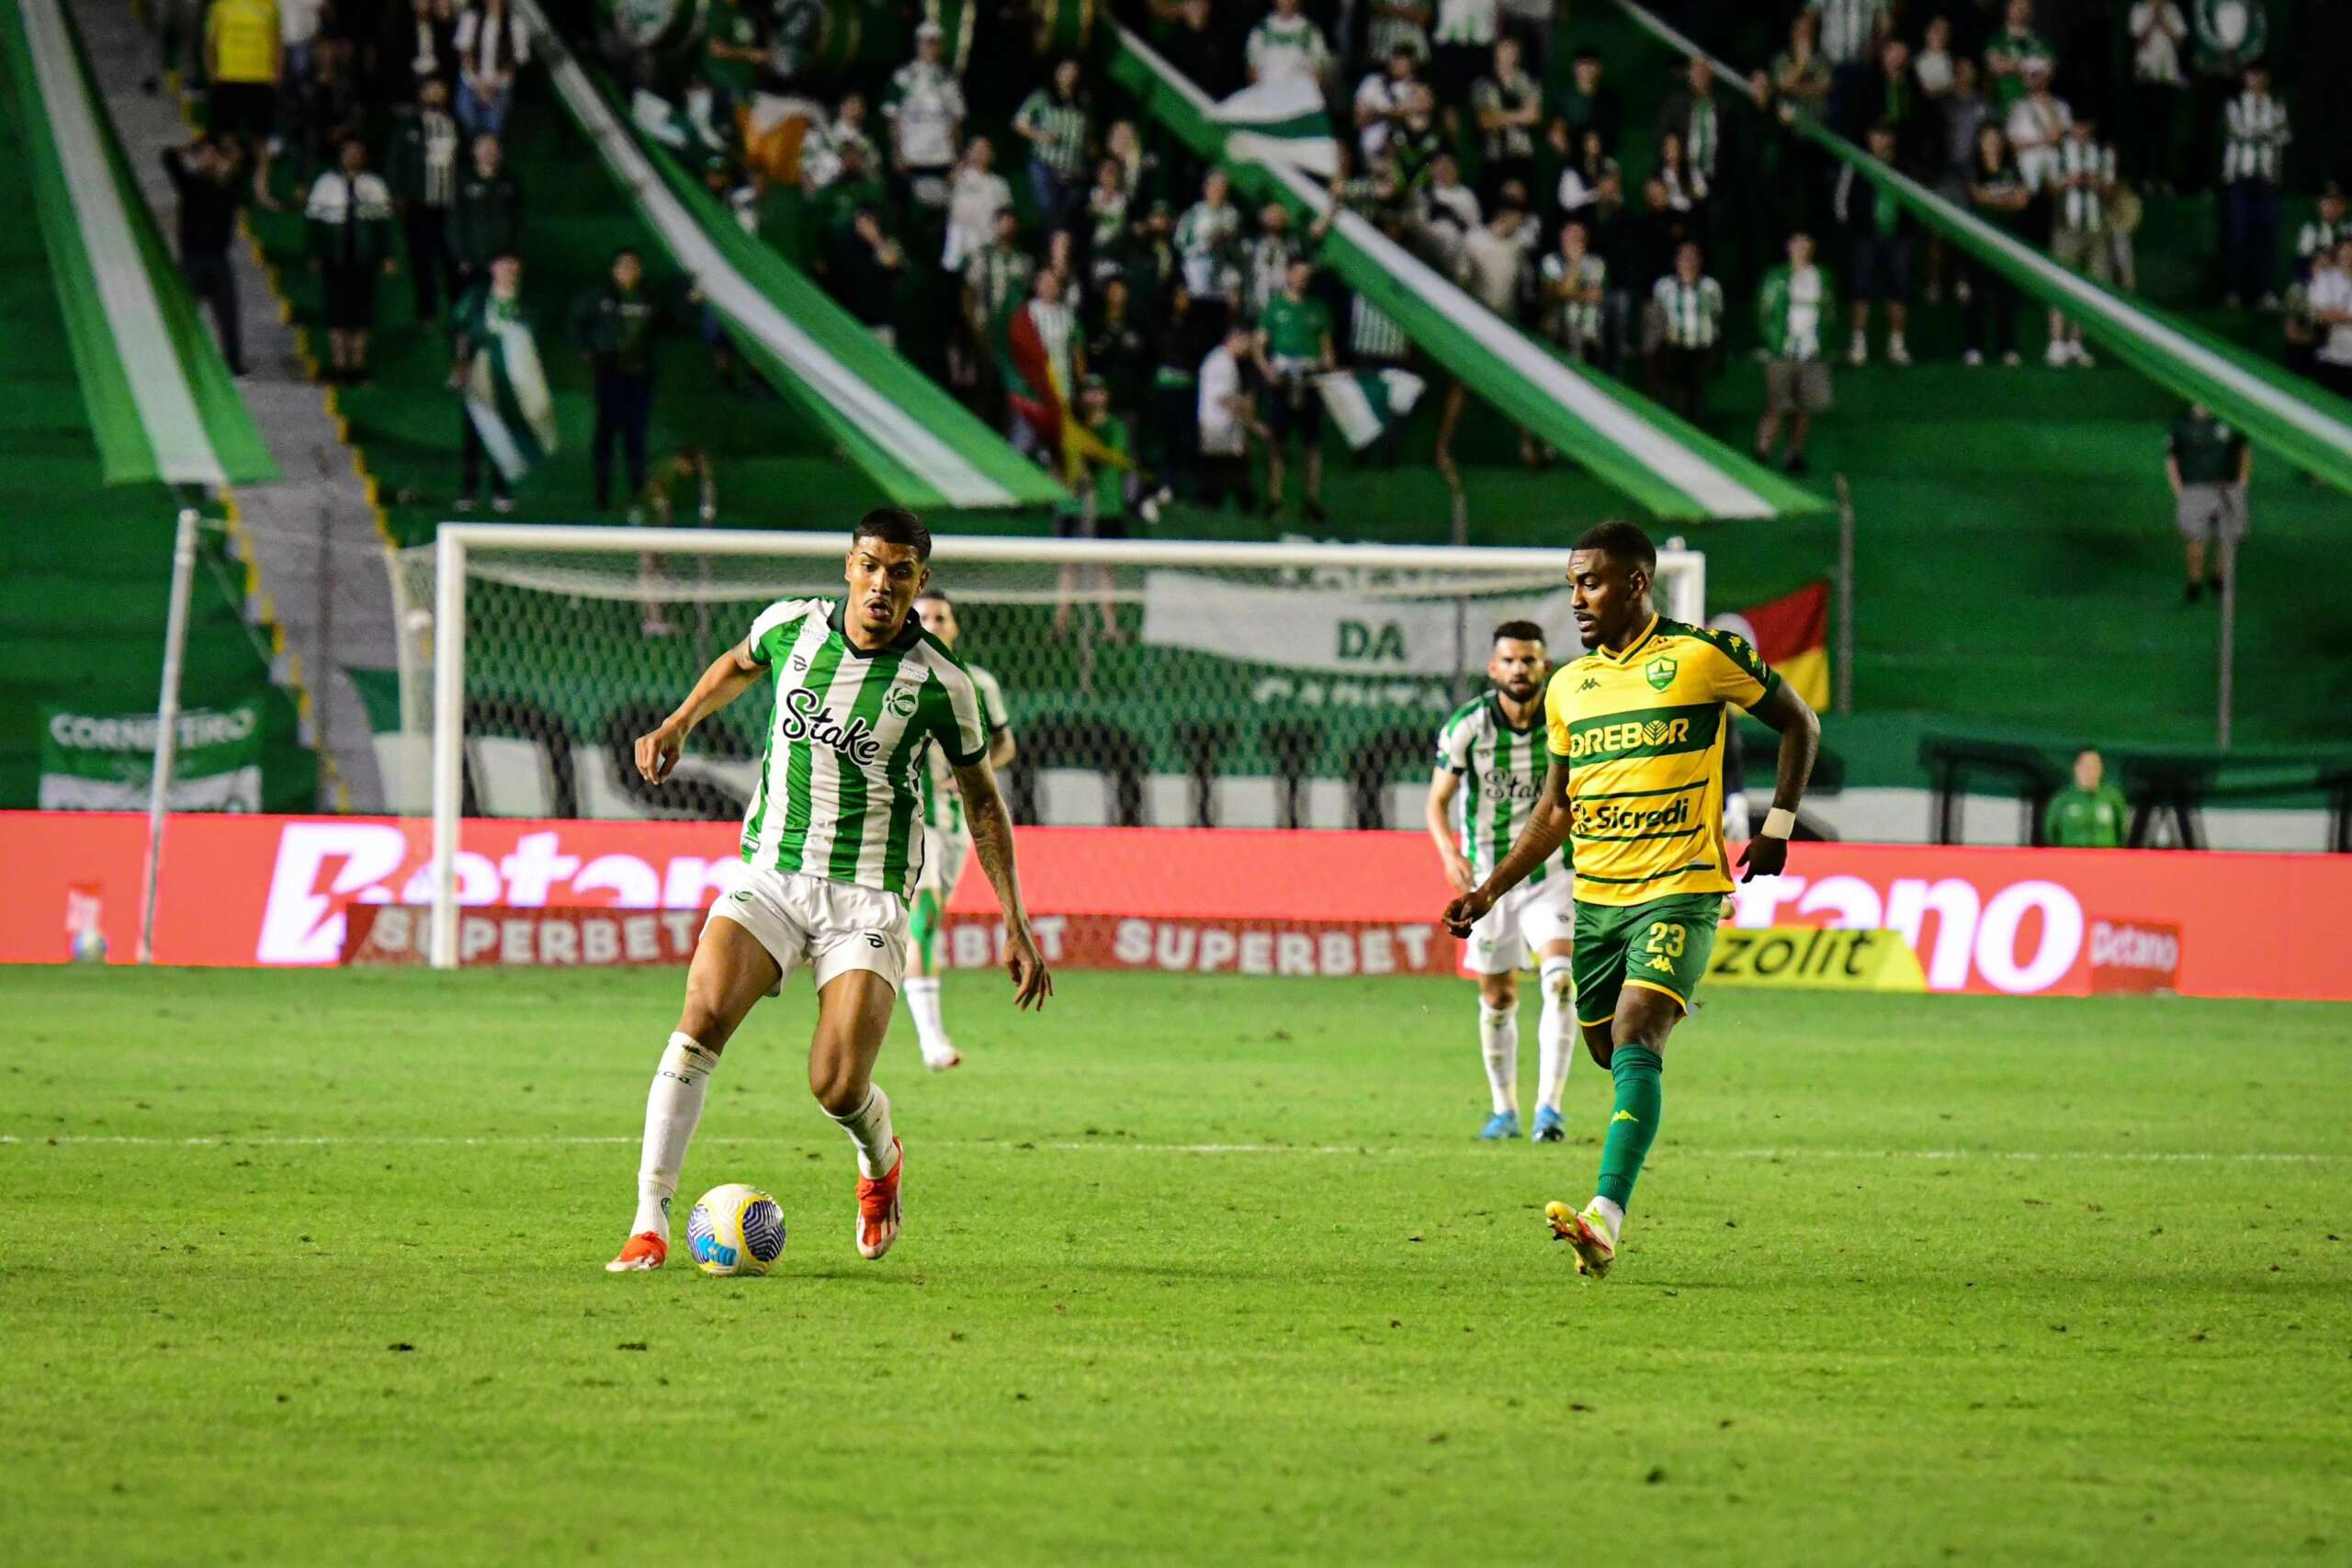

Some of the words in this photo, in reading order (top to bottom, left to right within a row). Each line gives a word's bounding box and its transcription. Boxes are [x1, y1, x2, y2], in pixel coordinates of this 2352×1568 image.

[1337, 618, 1406, 661] DA
[782, 688, 881, 766] Stake
[1597, 797, 1690, 829] Sicredi
[1113, 919, 1434, 976] SUPERBET
[1645, 921, 1686, 957] 23
